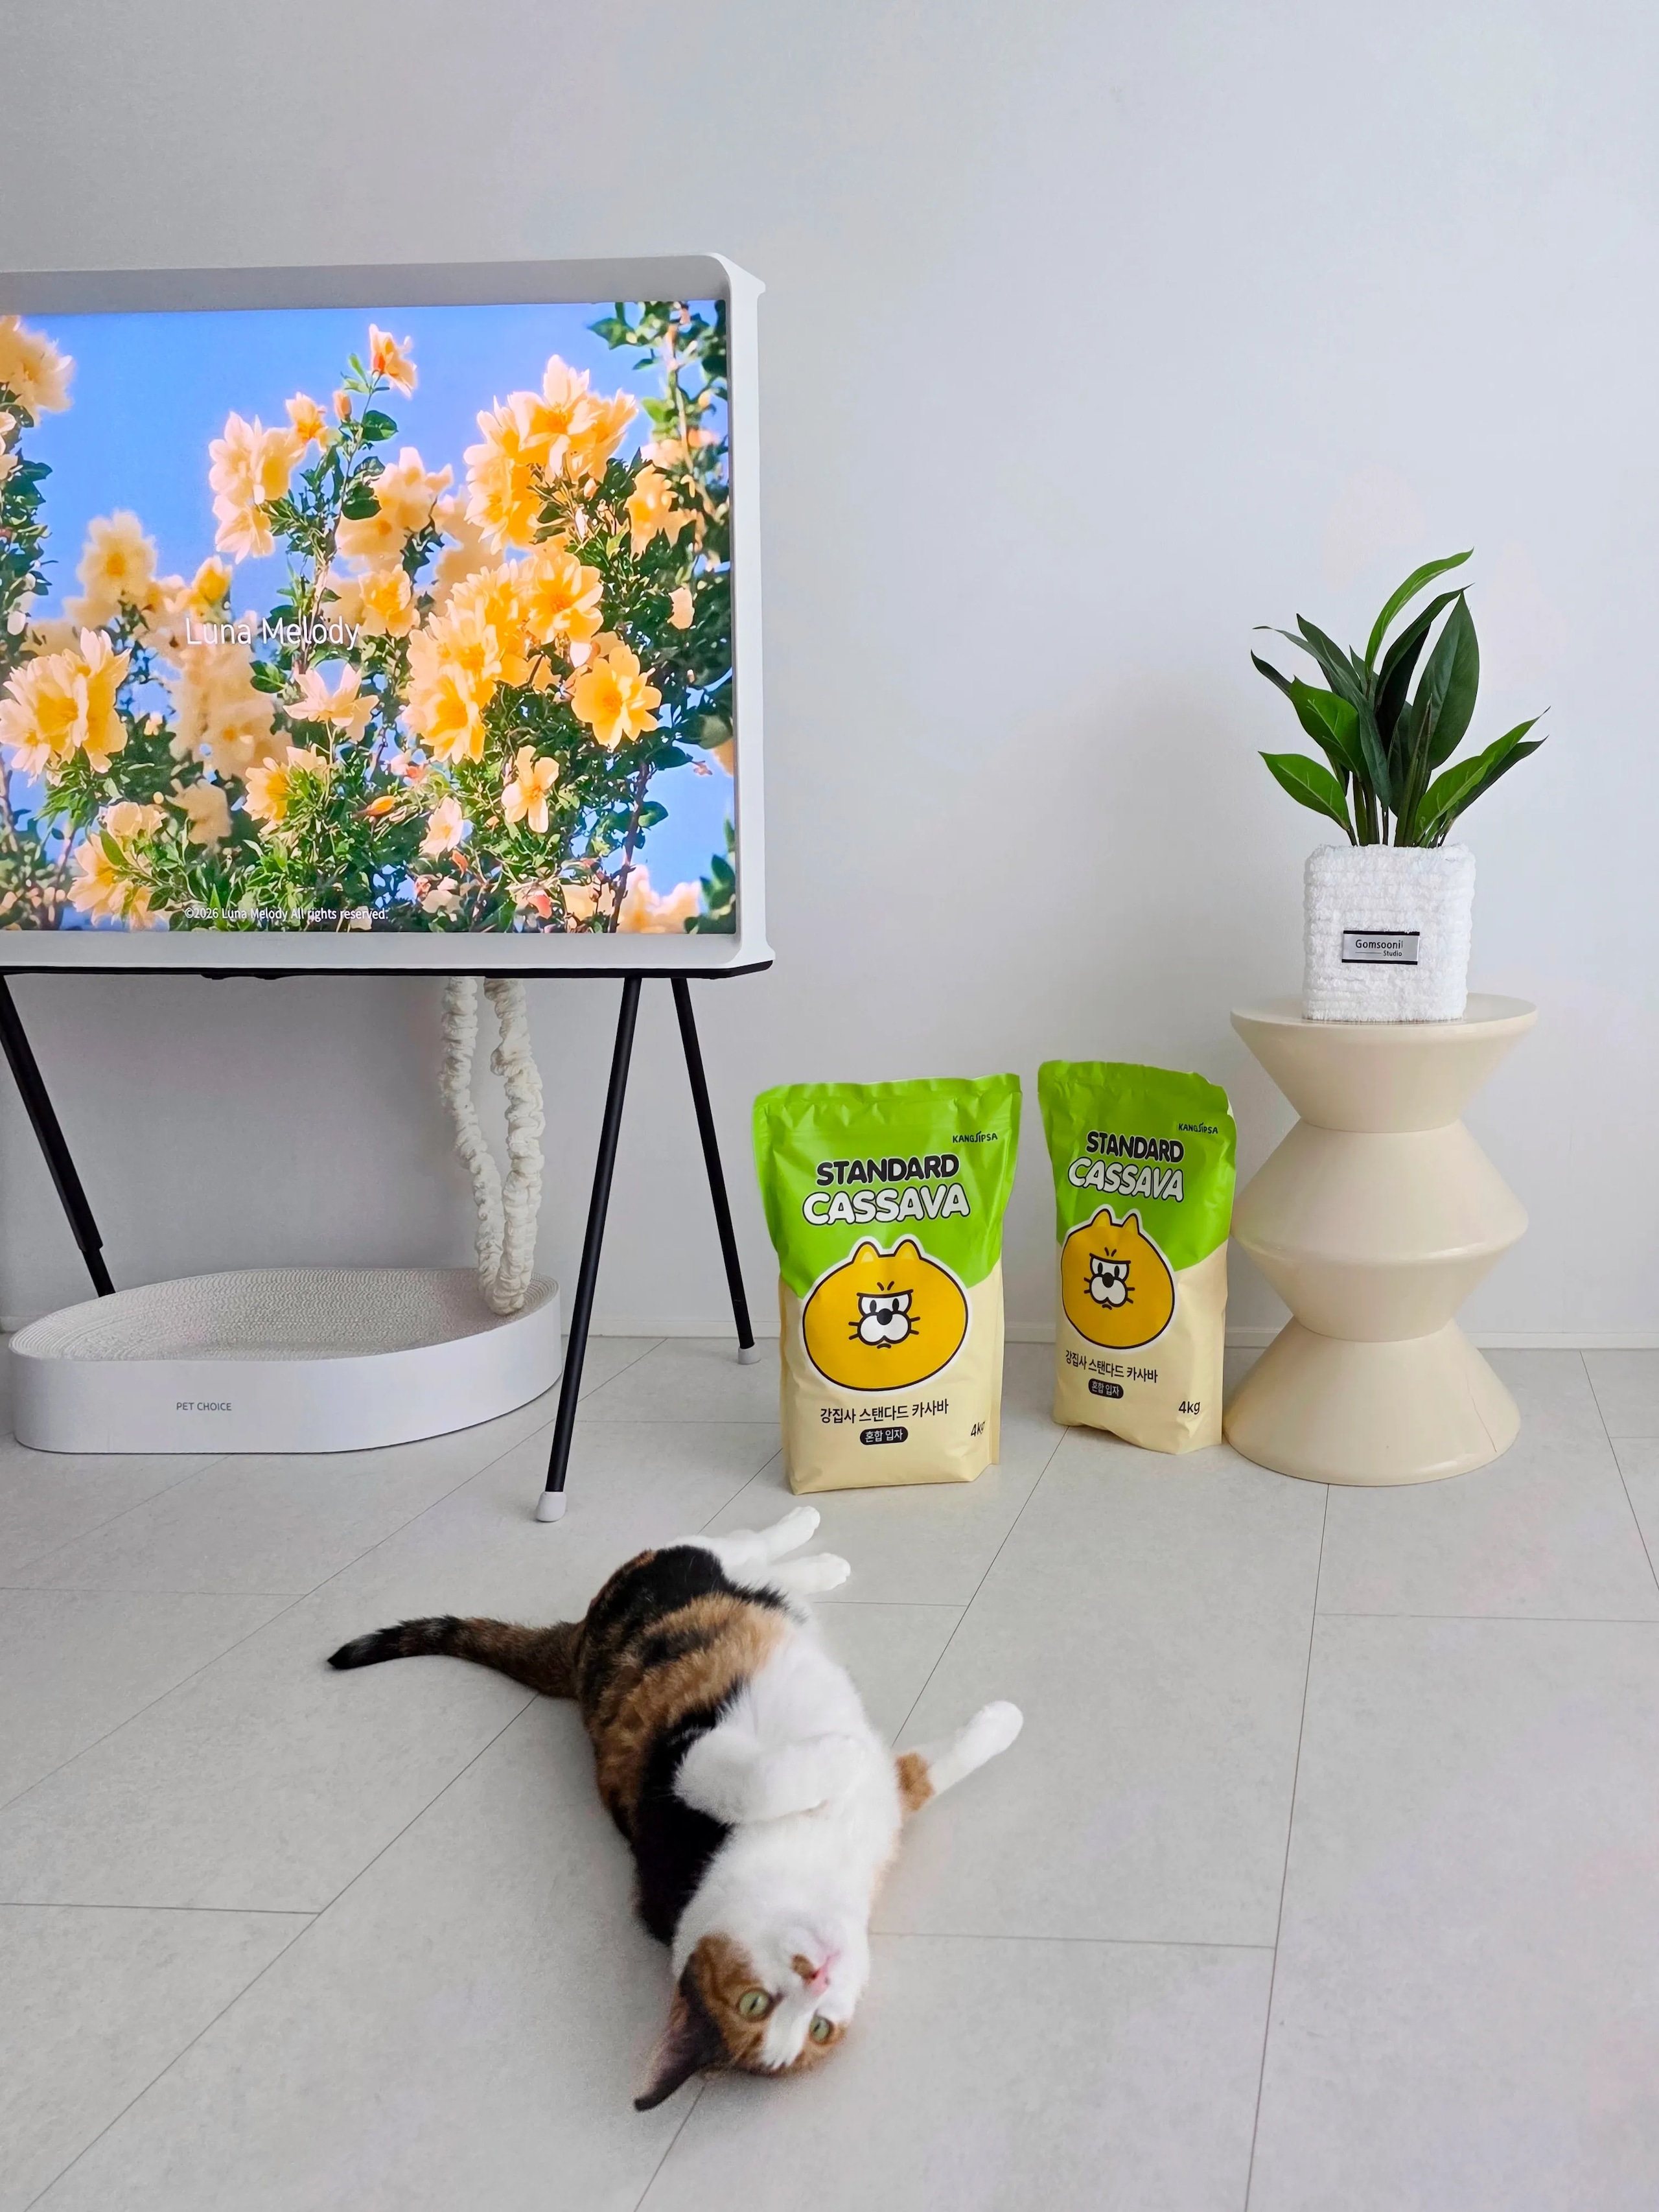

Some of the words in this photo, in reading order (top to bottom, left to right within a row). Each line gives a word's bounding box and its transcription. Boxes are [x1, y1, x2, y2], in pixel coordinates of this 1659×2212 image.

[185, 616, 251, 645] Luna
[262, 615, 360, 651] Melody
[222, 907, 247, 919] Luna
[250, 907, 288, 922] Melody
[291, 907, 305, 919] All
[307, 907, 337, 922] rights
[340, 907, 389, 920] reserved.
[952, 1130, 998, 1143] KANGJIPSA
[1086, 1131, 1185, 1163] STANDARD
[817, 1154, 960, 1186] STANDARD
[1068, 1156, 1184, 1203] CASSAVA
[802, 1183, 971, 1226] CASSAVA
[1065, 1349, 1087, 1370] 강집사
[1088, 1358, 1124, 1378] 스탠다드
[1126, 1366, 1159, 1383] 카사바
[1091, 1380, 1105, 1394] 혼합
[1105, 1384, 1120, 1397] 입자
[176, 1402, 194, 1411] PET
[196, 1402, 232, 1412] CHOICE
[820, 1407, 857, 1424] 강집사
[859, 1405, 909, 1422] 스탠다드
[912, 1398, 949, 1418] 카사바
[1178, 1401, 1201, 1415] 4kg
[864, 1430, 884, 1443] 혼합
[885, 1428, 903, 1441] 입자
